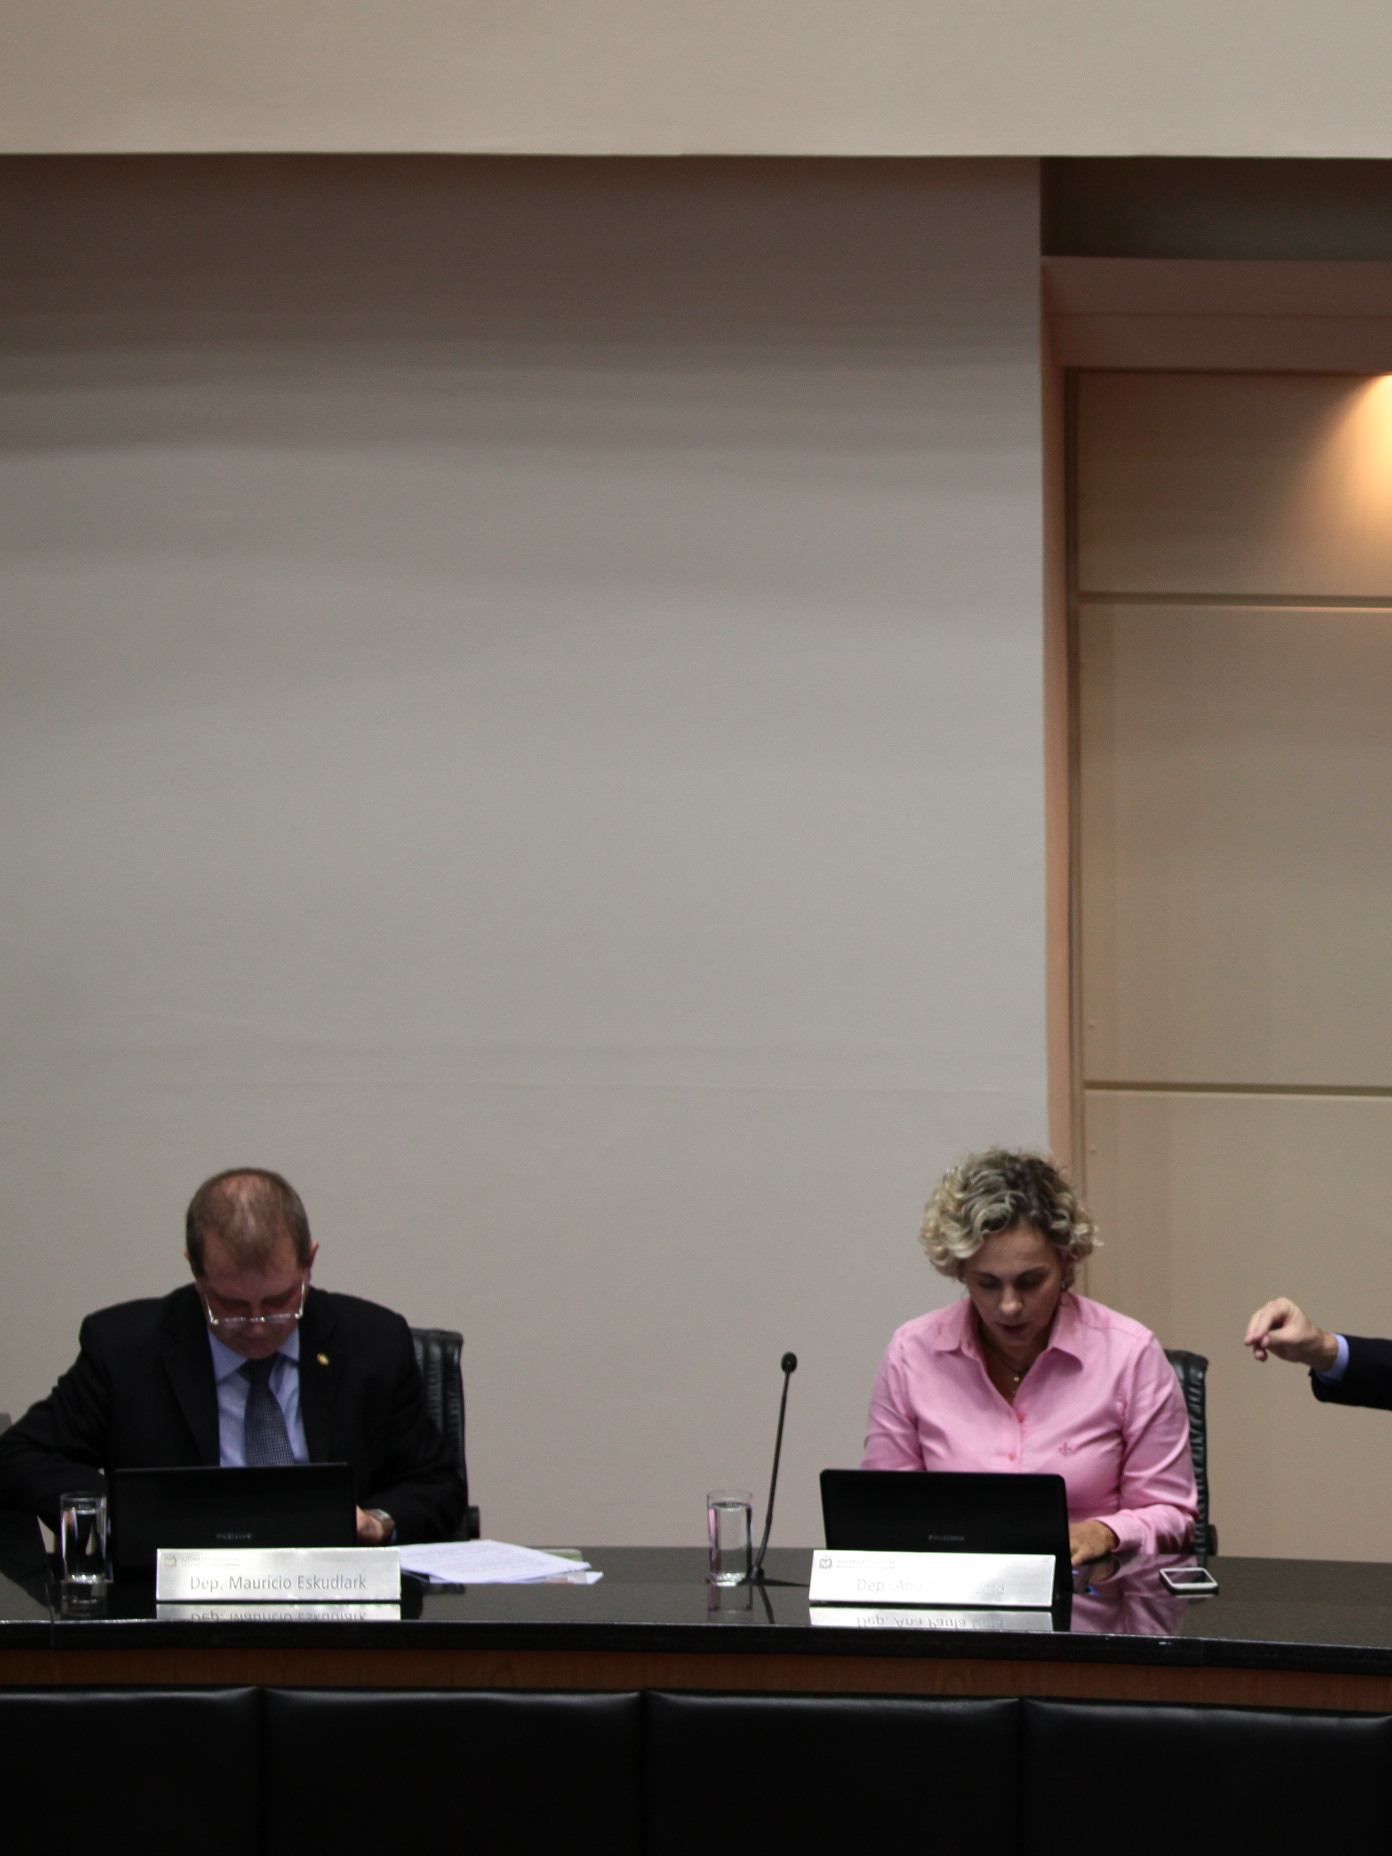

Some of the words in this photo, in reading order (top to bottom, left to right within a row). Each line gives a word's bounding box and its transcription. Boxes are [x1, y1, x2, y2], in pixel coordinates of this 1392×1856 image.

[190, 1575, 223, 1592] Dep.
[228, 1574, 292, 1591] Maurício
[297, 1574, 367, 1591] Eskudlark
